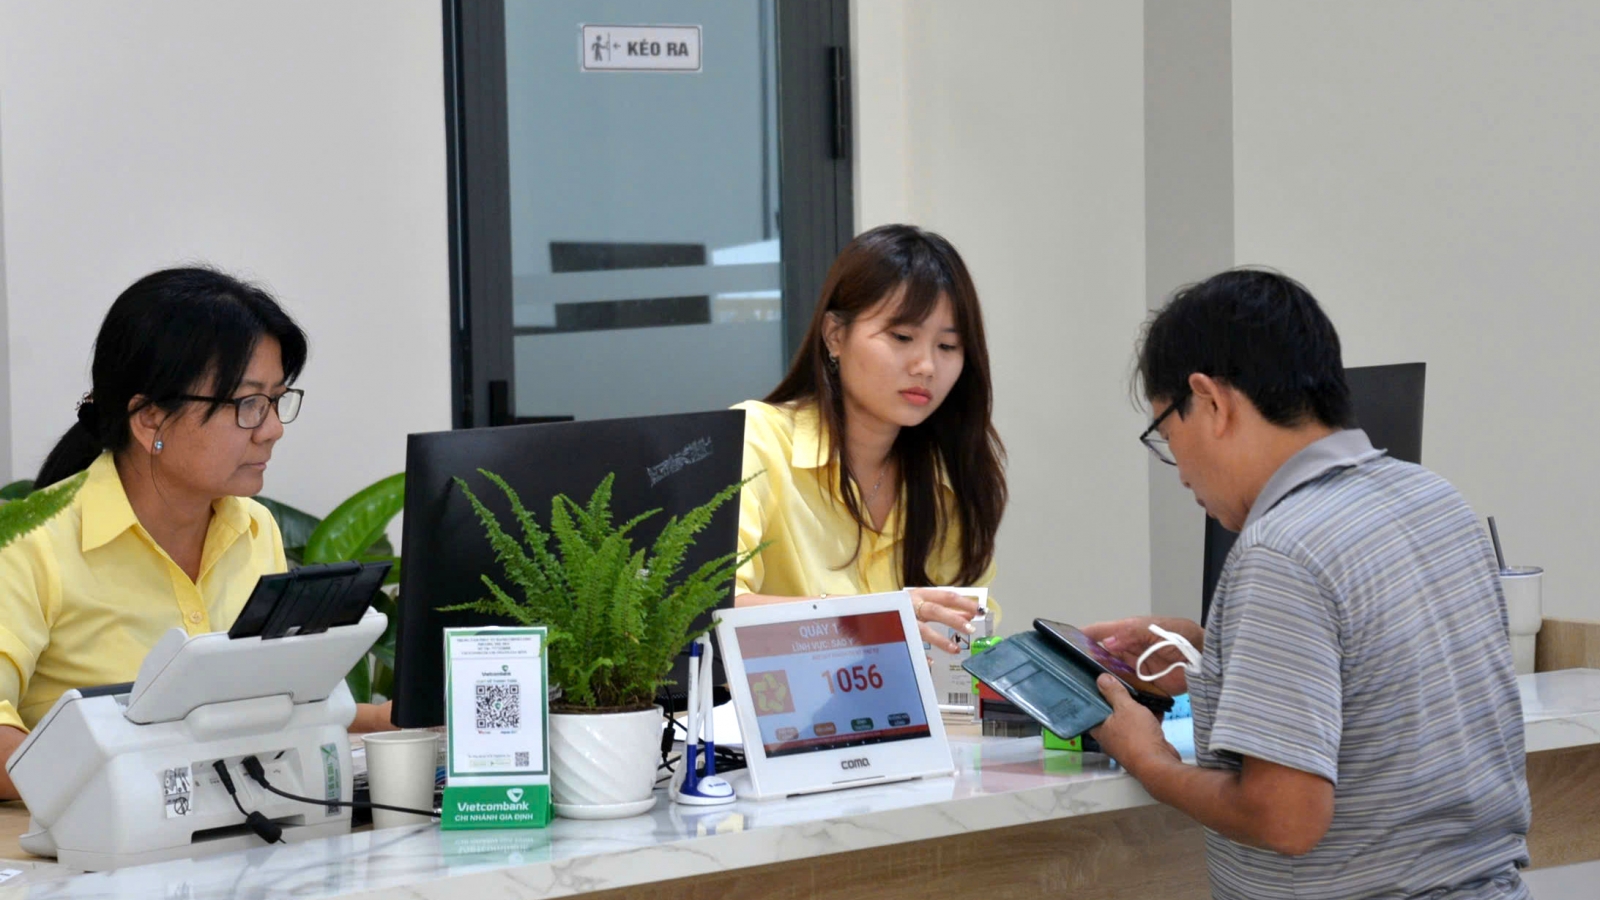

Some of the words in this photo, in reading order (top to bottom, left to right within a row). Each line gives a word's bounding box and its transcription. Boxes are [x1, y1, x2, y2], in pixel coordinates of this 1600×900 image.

[627, 39, 661, 56] KÉO
[667, 42, 689, 56] RA
[832, 624, 839, 635] 1
[820, 663, 884, 695] 1056
[457, 801, 529, 812] Vietcombank
[454, 814, 468, 822] CHI
[469, 813, 498, 821] NHÁNH
[514, 813, 534, 821] ĐỊNH
